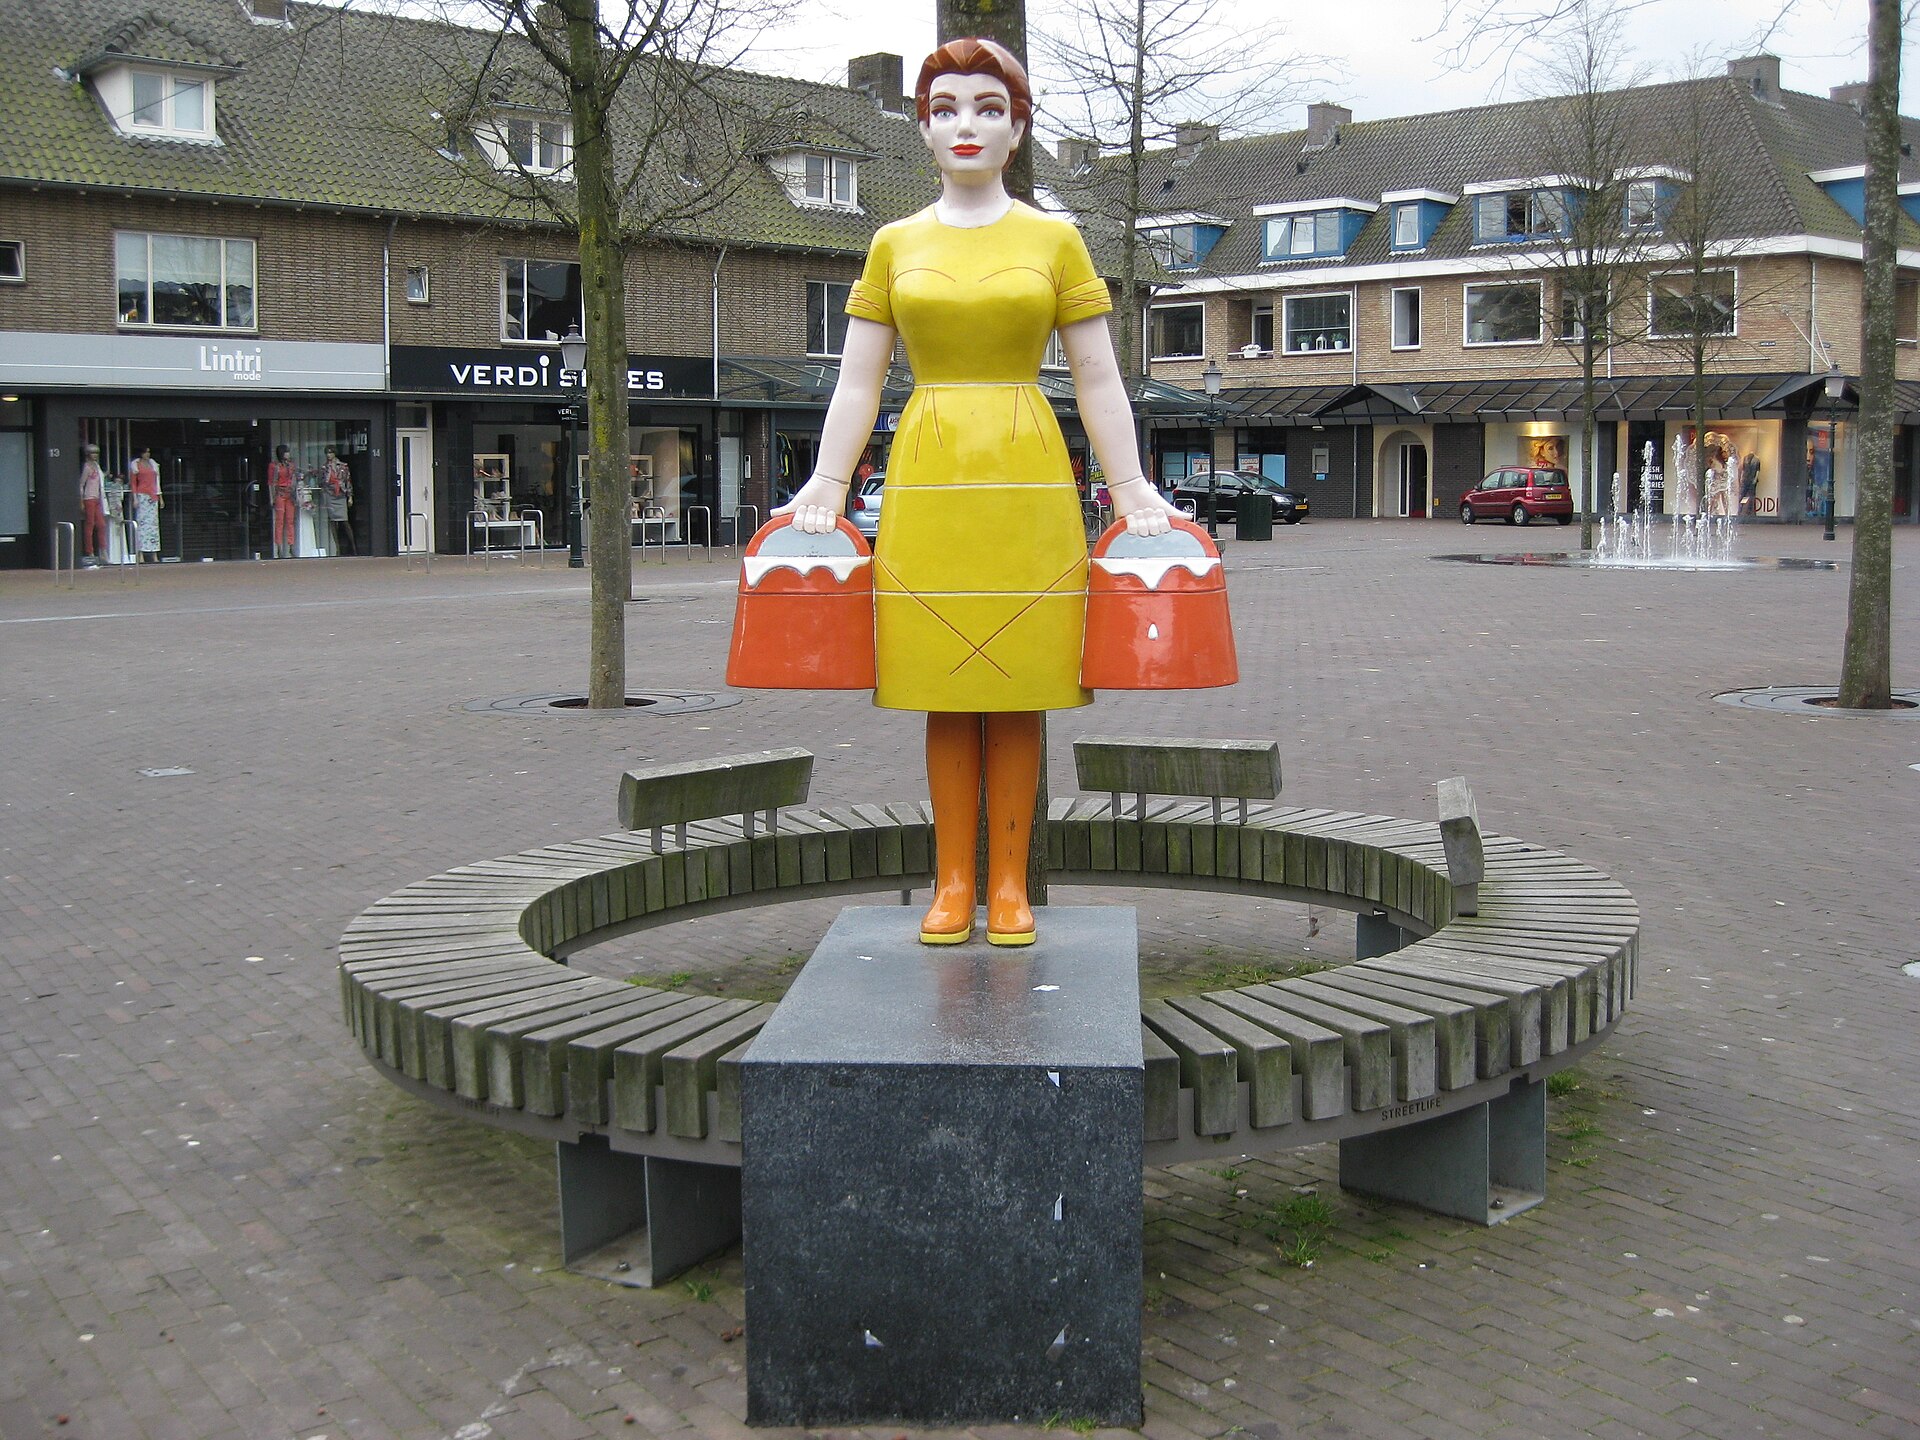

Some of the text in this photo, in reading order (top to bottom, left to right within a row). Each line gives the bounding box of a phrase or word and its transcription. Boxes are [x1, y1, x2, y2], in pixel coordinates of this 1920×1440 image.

[200, 345, 262, 372] Lintri
[234, 370, 262, 381] mode
[559, 368, 665, 390] SES
[1754, 497, 1779, 512] DIDI
[1381, 1097, 1441, 1121] STREETLIFE
